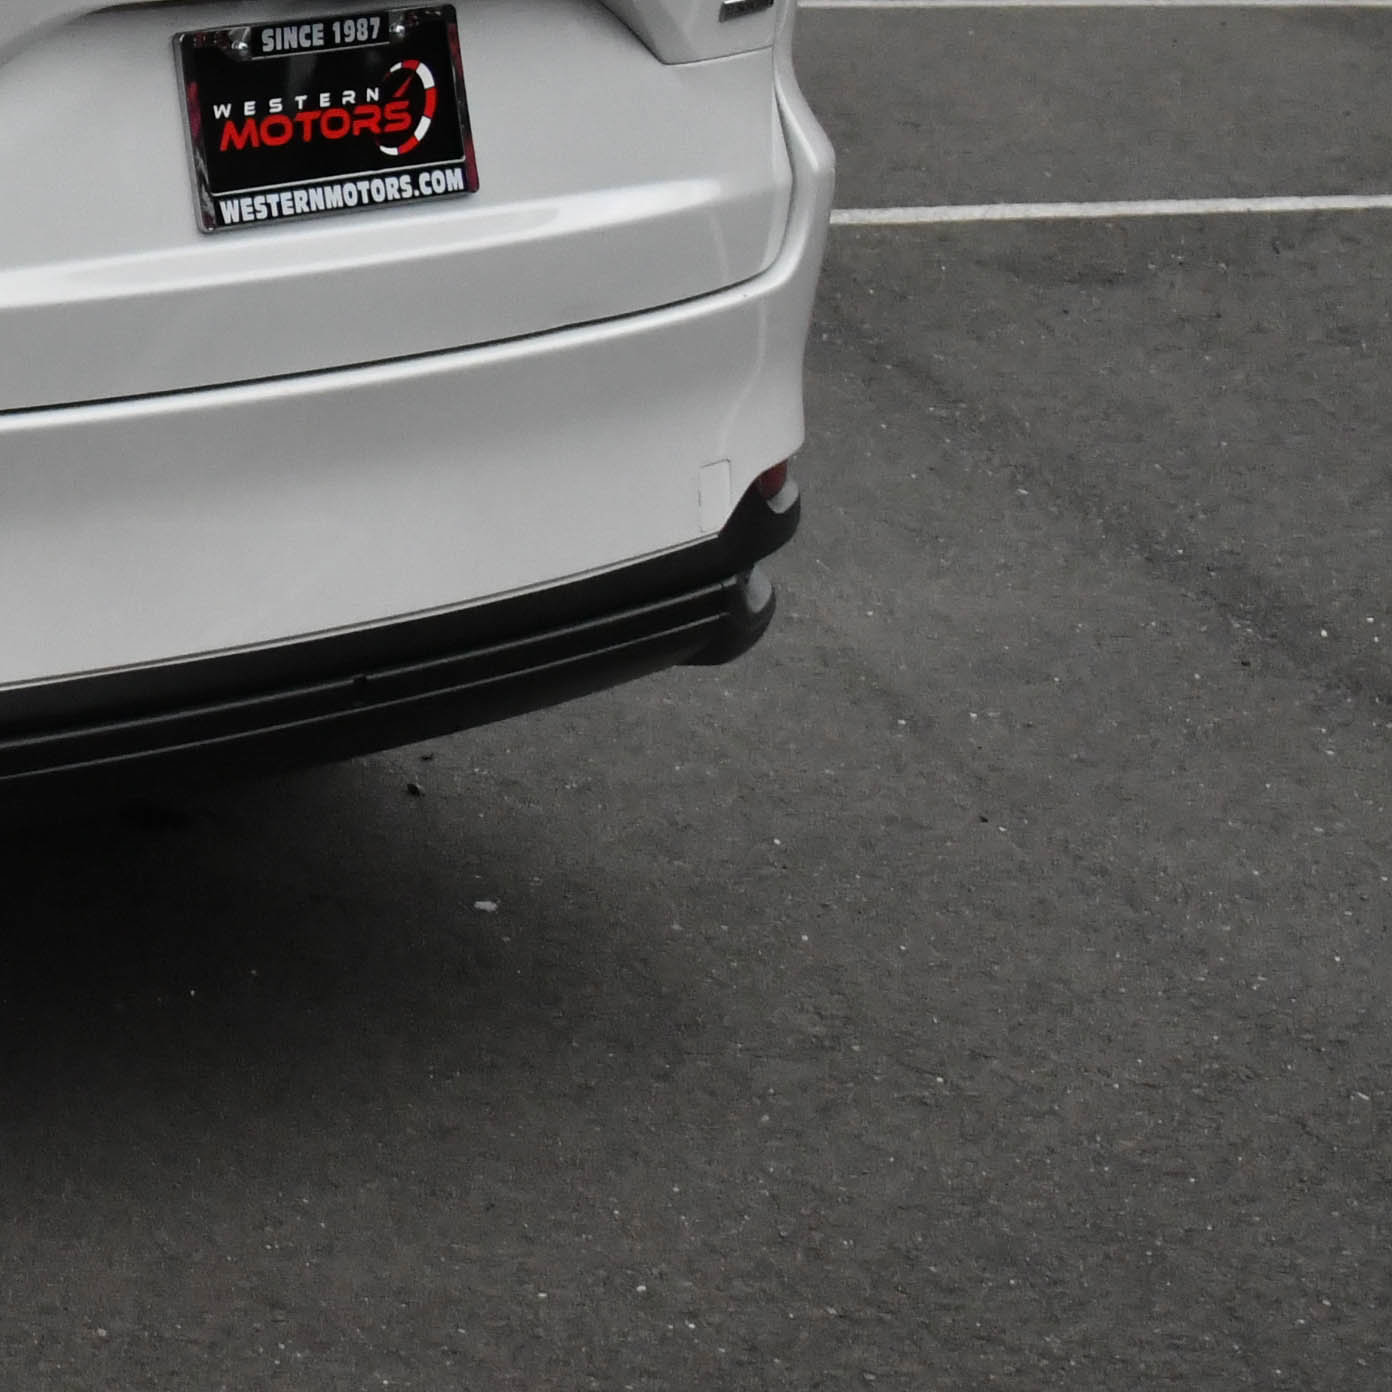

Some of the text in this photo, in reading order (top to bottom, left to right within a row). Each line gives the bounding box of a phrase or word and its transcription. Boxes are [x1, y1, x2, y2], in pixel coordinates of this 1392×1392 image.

[261, 17, 381, 52] SINCE 1987
[214, 88, 380, 119] WESTERN
[220, 100, 413, 152] MOTORS
[219, 167, 465, 225] WESTERNMOTORS.COM
